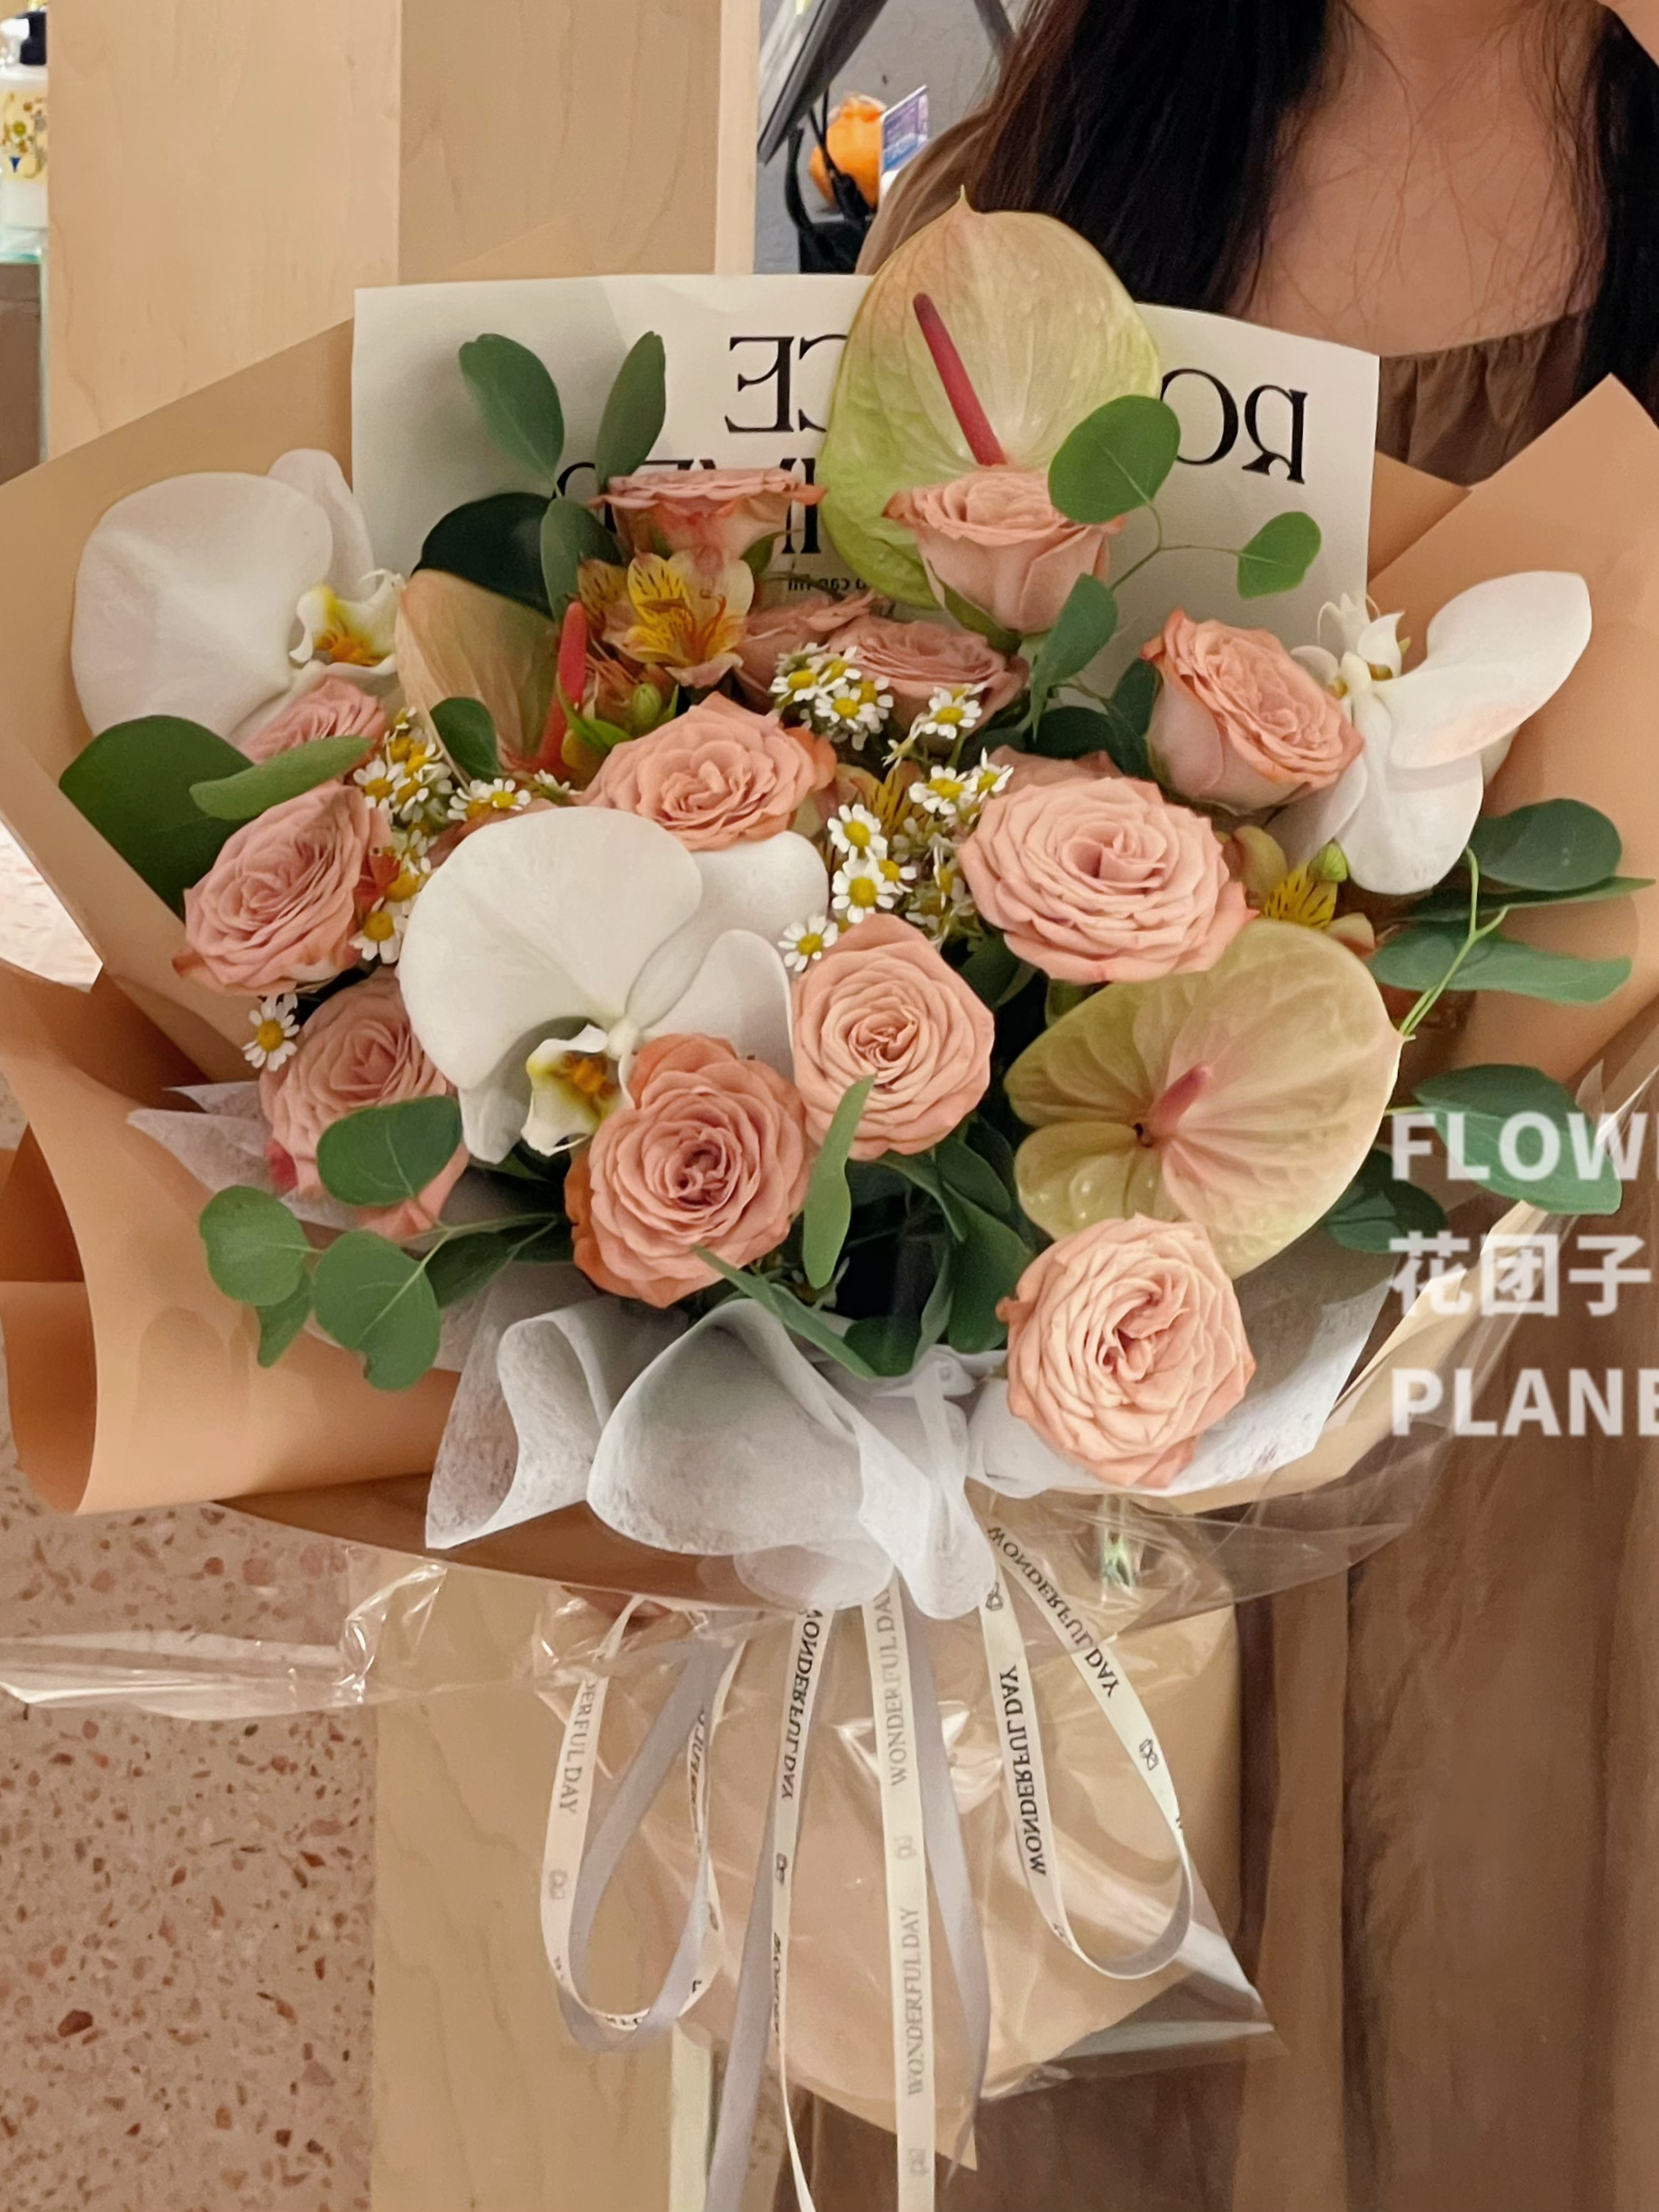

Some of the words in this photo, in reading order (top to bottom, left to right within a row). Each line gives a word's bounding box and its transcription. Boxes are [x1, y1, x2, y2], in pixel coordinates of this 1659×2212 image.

[880, 1635, 907, 1787] WONDERFUL
[559, 1766, 583, 1814] DAY
[899, 1906, 921, 1949] DAY
[902, 1951, 925, 2096] WONDERFUL
